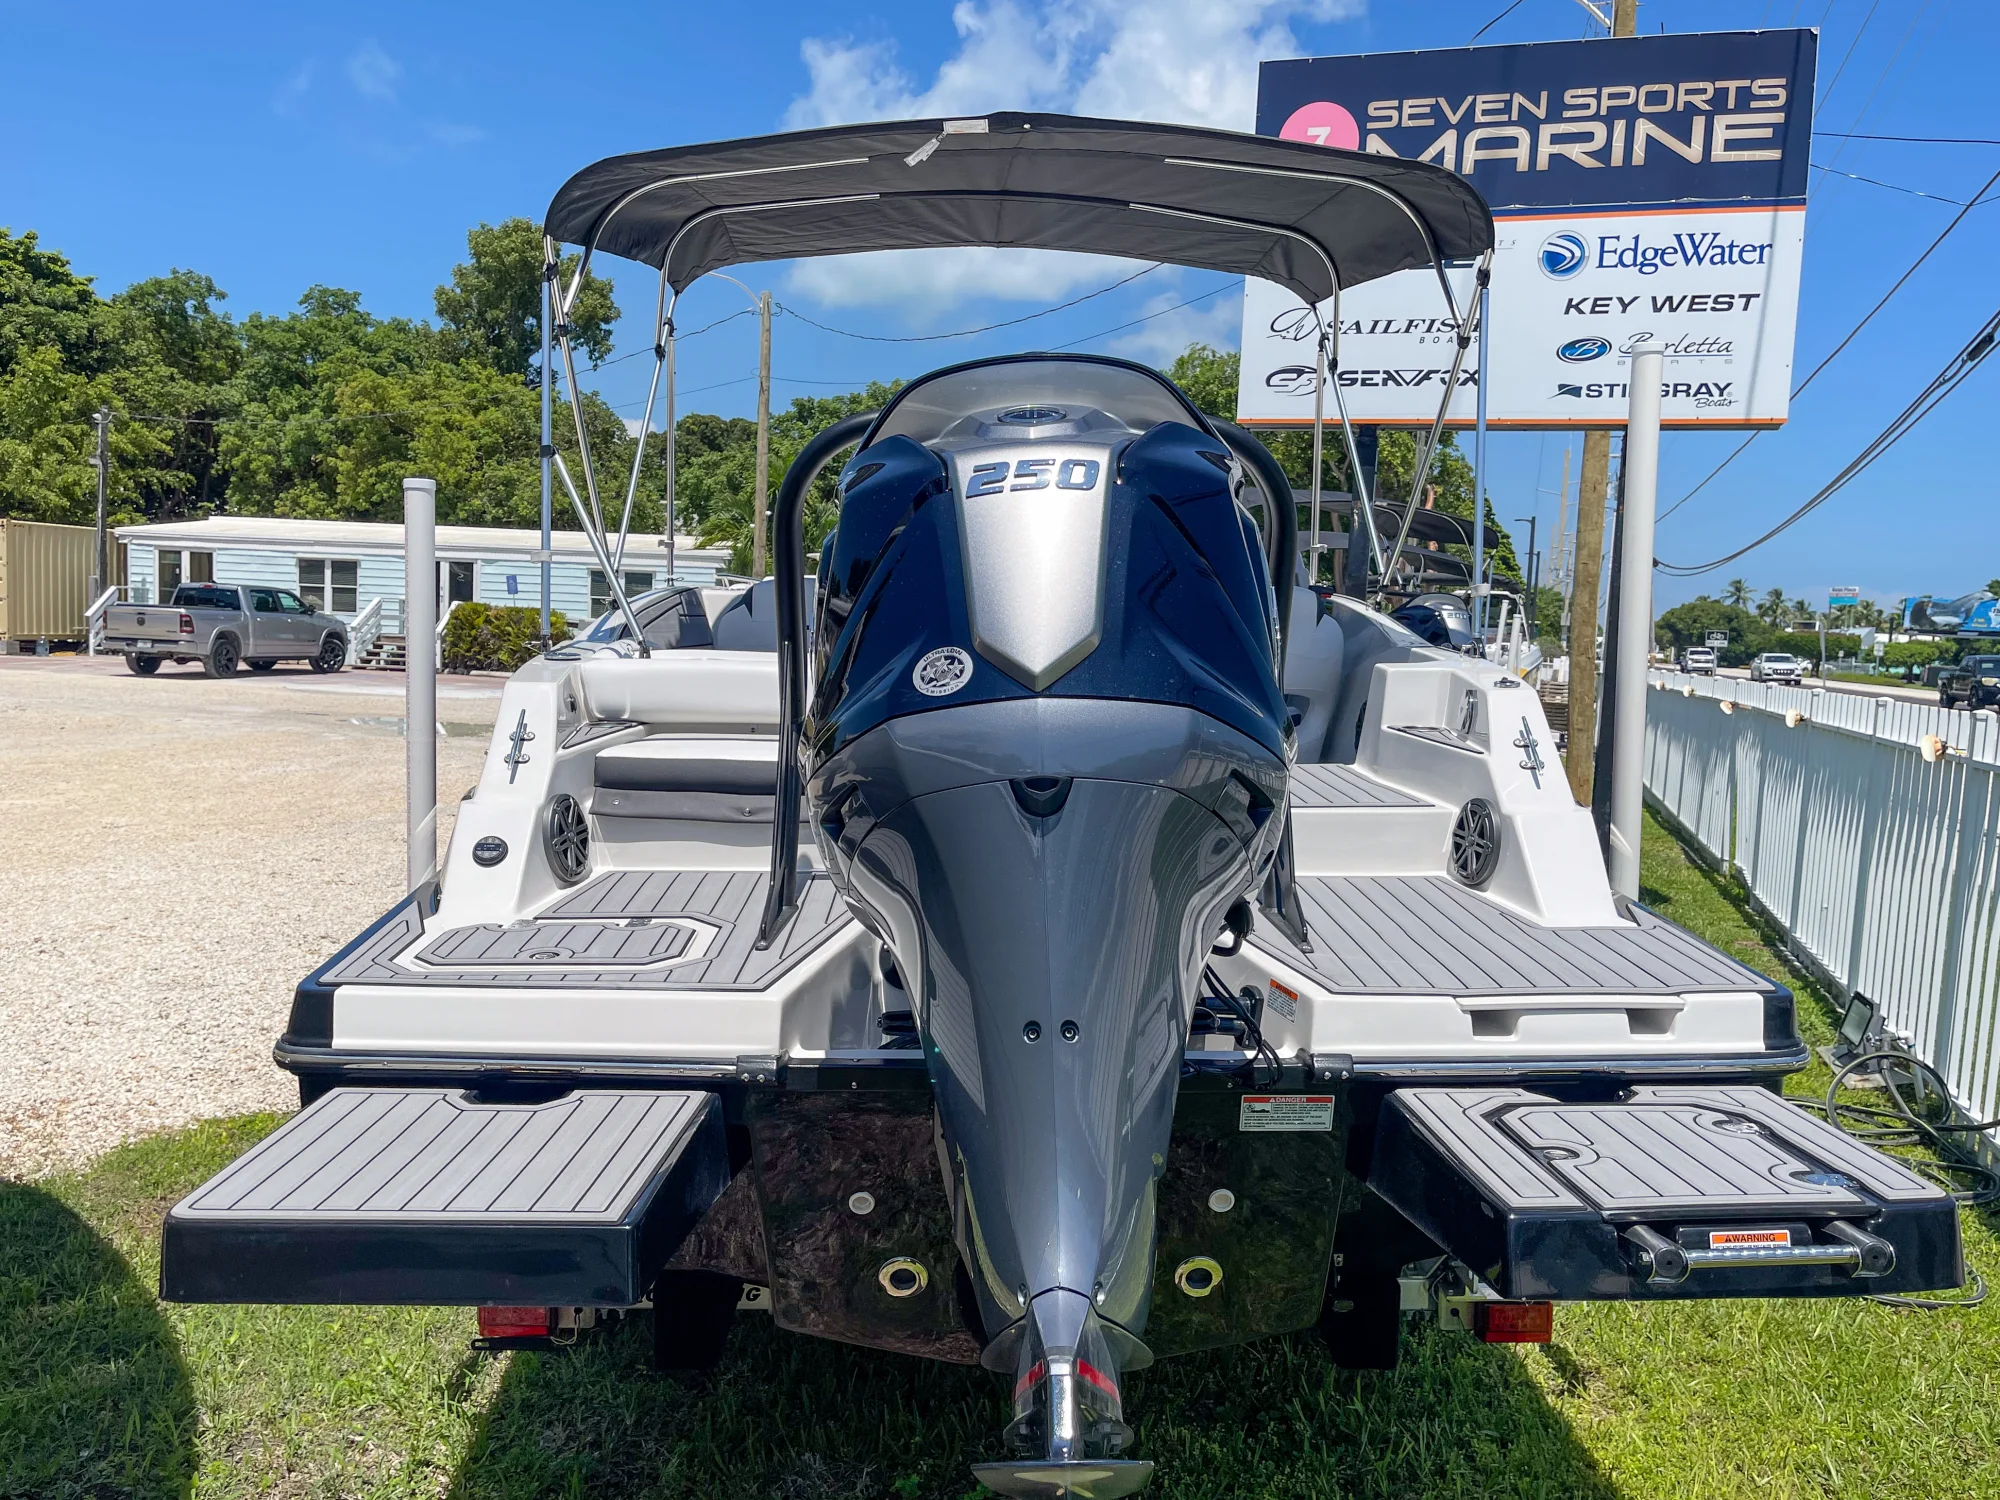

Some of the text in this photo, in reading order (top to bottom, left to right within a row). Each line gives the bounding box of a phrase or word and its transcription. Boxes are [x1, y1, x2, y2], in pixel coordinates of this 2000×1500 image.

[1366, 78, 1787, 129] SEVEN SPORTS
[1306, 126, 1331, 145] 7
[1366, 112, 1785, 175] MARINE
[1595, 232, 1773, 275] EdgeWater
[1563, 293, 1760, 315] KEY WEST
[1419, 335, 1479, 344] BOAS
[1618, 332, 1733, 354] Brletta
[1617, 358, 1733, 366] BATS
[1585, 382, 1733, 398] STIGRAY
[1694, 398, 1739, 408] Boats
[965, 458, 1100, 499] 250
[1732, 1233, 1776, 1242] WARNING
